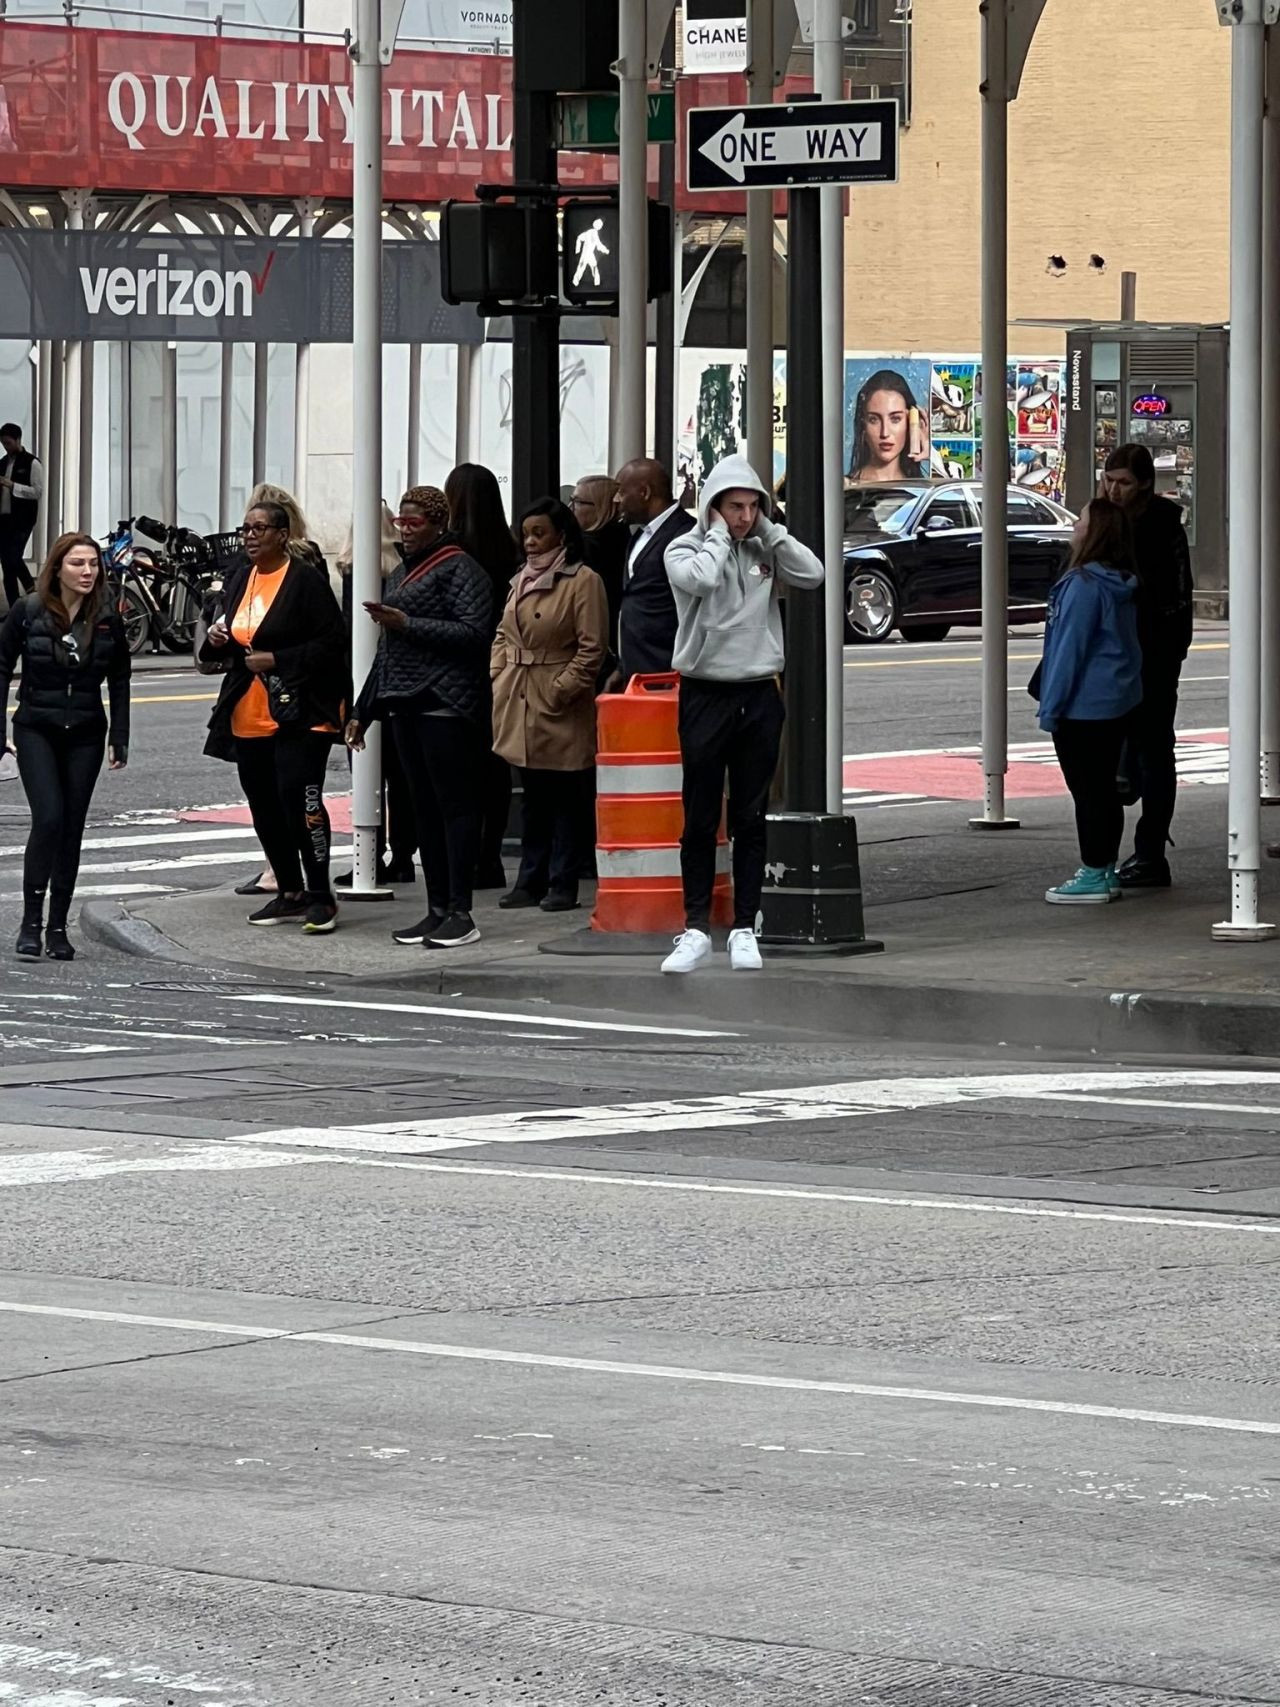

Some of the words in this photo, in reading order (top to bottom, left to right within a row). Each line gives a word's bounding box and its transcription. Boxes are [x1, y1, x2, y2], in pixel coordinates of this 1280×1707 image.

[108, 71, 355, 150] QUALITY
[387, 88, 513, 151] ITAL
[720, 131, 776, 164] ONE
[806, 127, 868, 160] WAY
[79, 253, 253, 318] verizon
[1072, 350, 1082, 411] Newsstand
[1133, 399, 1166, 413] OPEN
[305, 784, 319, 812] LOUIS
